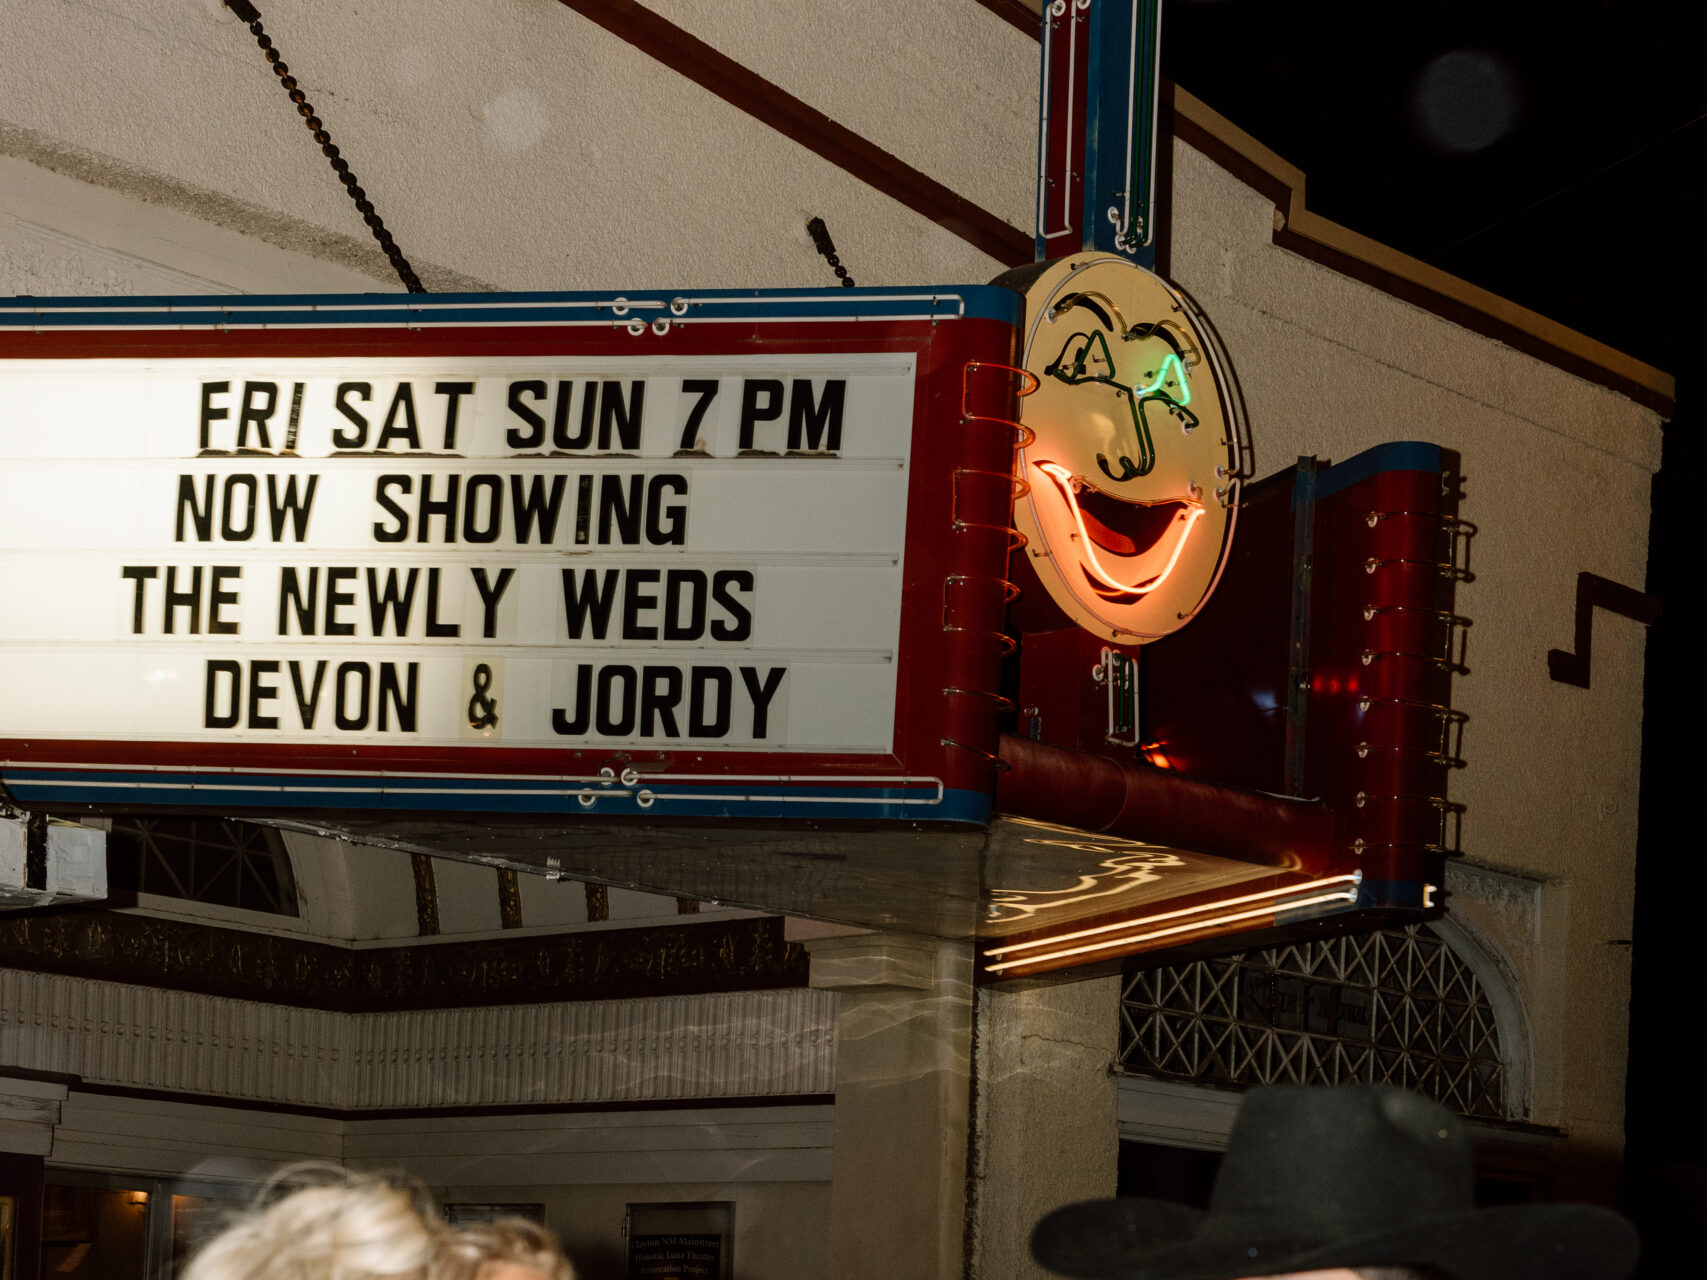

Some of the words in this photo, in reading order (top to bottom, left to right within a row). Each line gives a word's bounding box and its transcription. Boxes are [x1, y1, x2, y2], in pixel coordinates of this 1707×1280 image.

[200, 380, 305, 450] FRI
[332, 381, 476, 450] SAT
[506, 379, 646, 451] SUN
[679, 380, 720, 450] 7
[737, 379, 847, 451] PM
[175, 474, 320, 543] NOW
[373, 474, 689, 546] SHOWING
[121, 566, 243, 635] THE
[278, 567, 517, 639] NEWLY
[561, 568, 756, 642] WEDS
[204, 659, 420, 732] DEVON
[467, 663, 499, 731] &
[551, 664, 788, 739] JORDY
